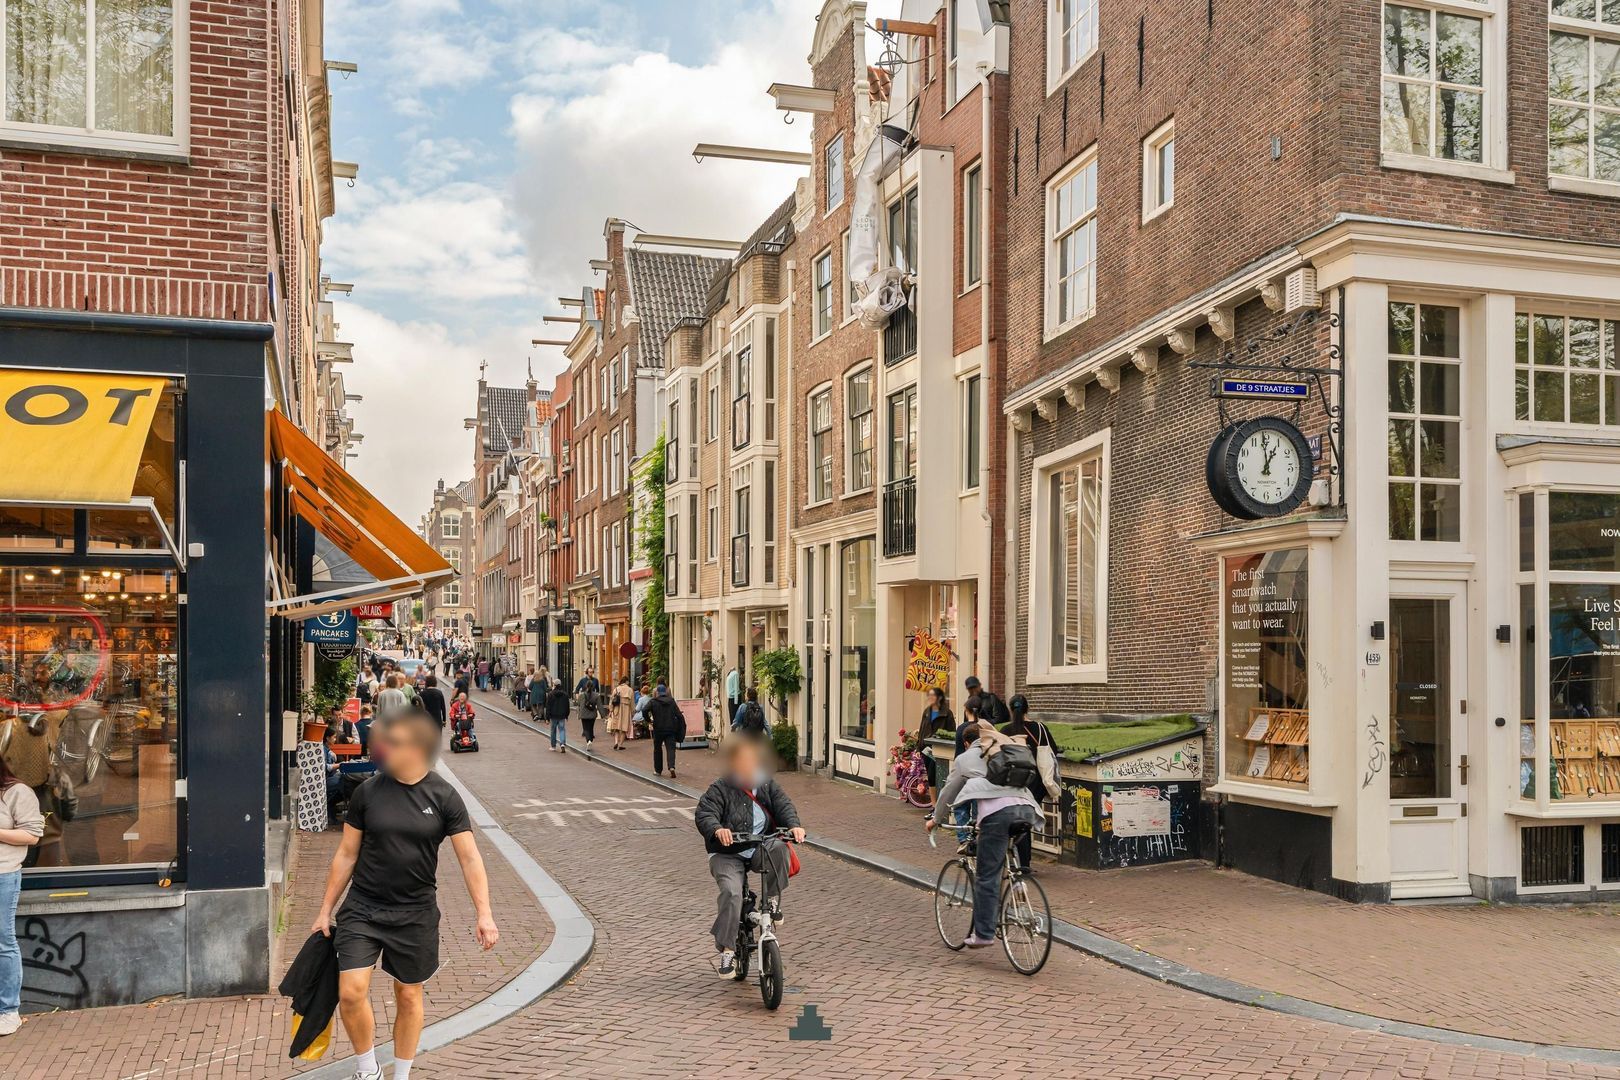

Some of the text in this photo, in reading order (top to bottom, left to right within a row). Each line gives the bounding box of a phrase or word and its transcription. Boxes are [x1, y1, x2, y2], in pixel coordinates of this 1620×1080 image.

[1254, 384, 1295, 394] STRAATJES
[4, 384, 152, 426] OT
[1232, 568, 1264, 582] The first
[1232, 582, 1276, 598] smartwatch
[360, 605, 382, 616] SALADS
[1232, 598, 1298, 616] that you actually
[1584, 598, 1610, 612] Live
[1232, 618, 1284, 630] want to wear.
[1590, 618, 1614, 631] Feel
[310, 629, 350, 638] PANCAKES
